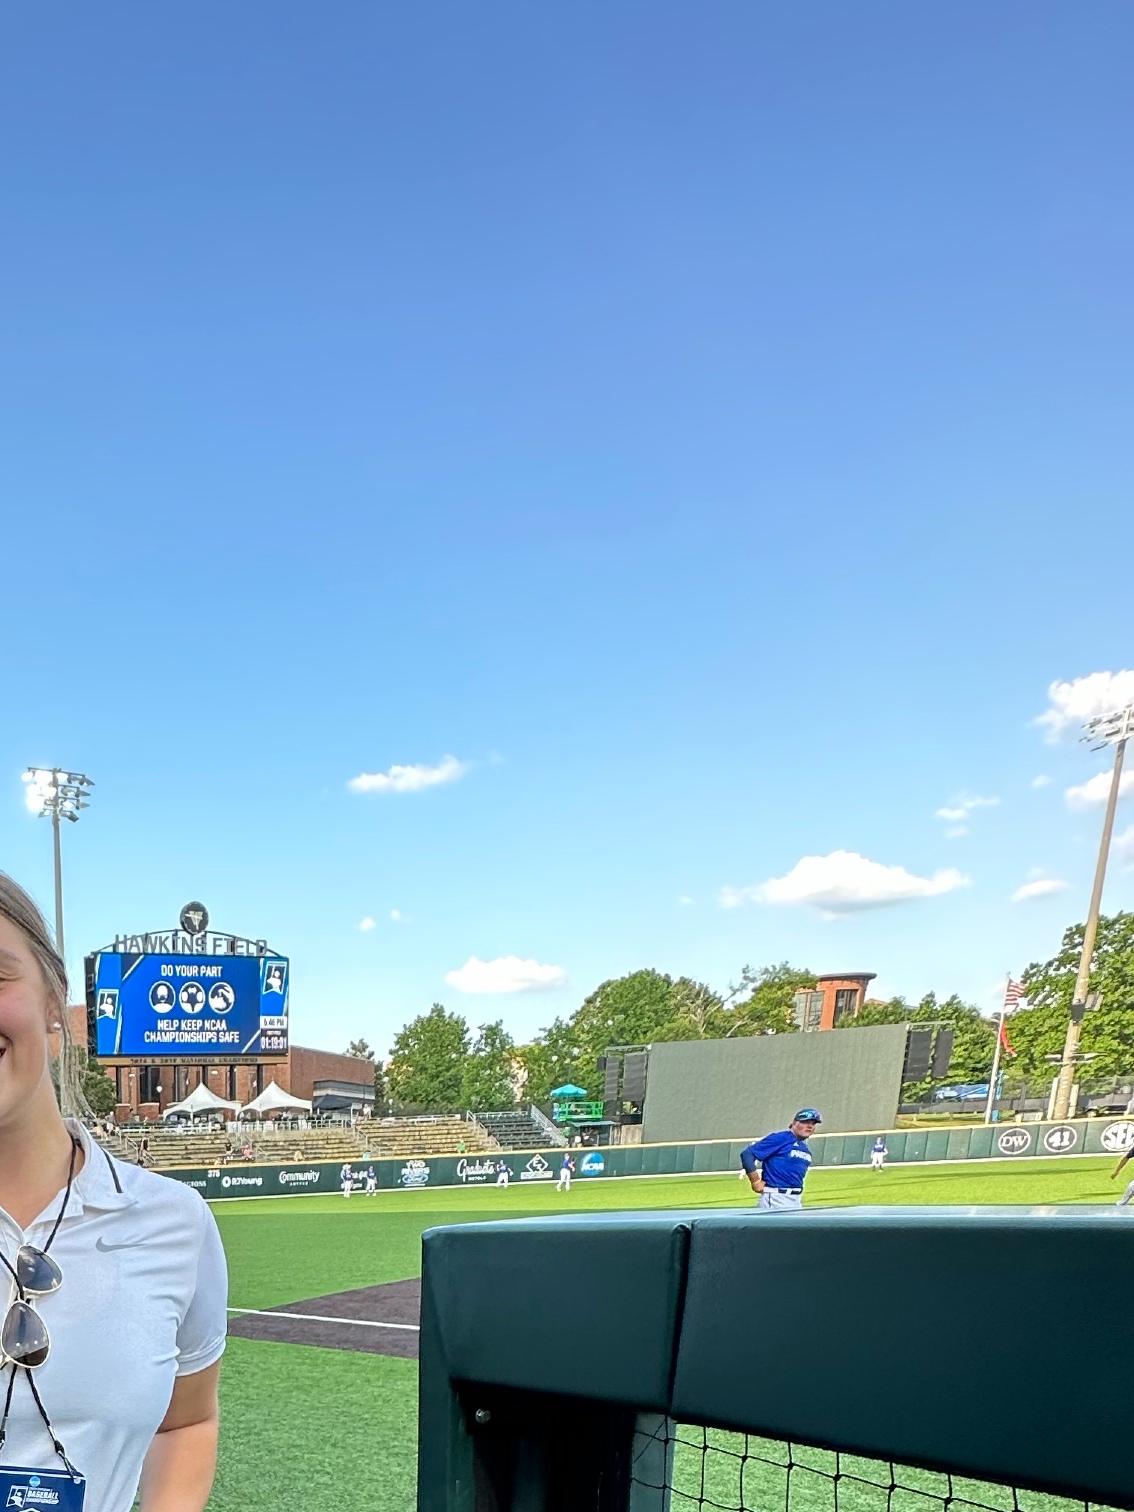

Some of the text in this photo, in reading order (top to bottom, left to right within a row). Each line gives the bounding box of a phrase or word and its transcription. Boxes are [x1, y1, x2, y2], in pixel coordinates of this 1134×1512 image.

[116, 934, 267, 957] HAWKINS FIELD
[161, 965, 222, 977] DO YOUR PART
[157, 1019, 227, 1031] HELP KEEP NCAA
[144, 1031, 240, 1043] CHAMPIONSHIPS SAFE
[1001, 1135, 1028, 1147] DW
[1049, 1131, 1070, 1147] 41
[581, 1162, 605, 1172] NCAA
[232, 1177, 263, 1186] RJYoung
[279, 1170, 320, 1184] Community
[27, 1490, 59, 1499] BASEBALL
